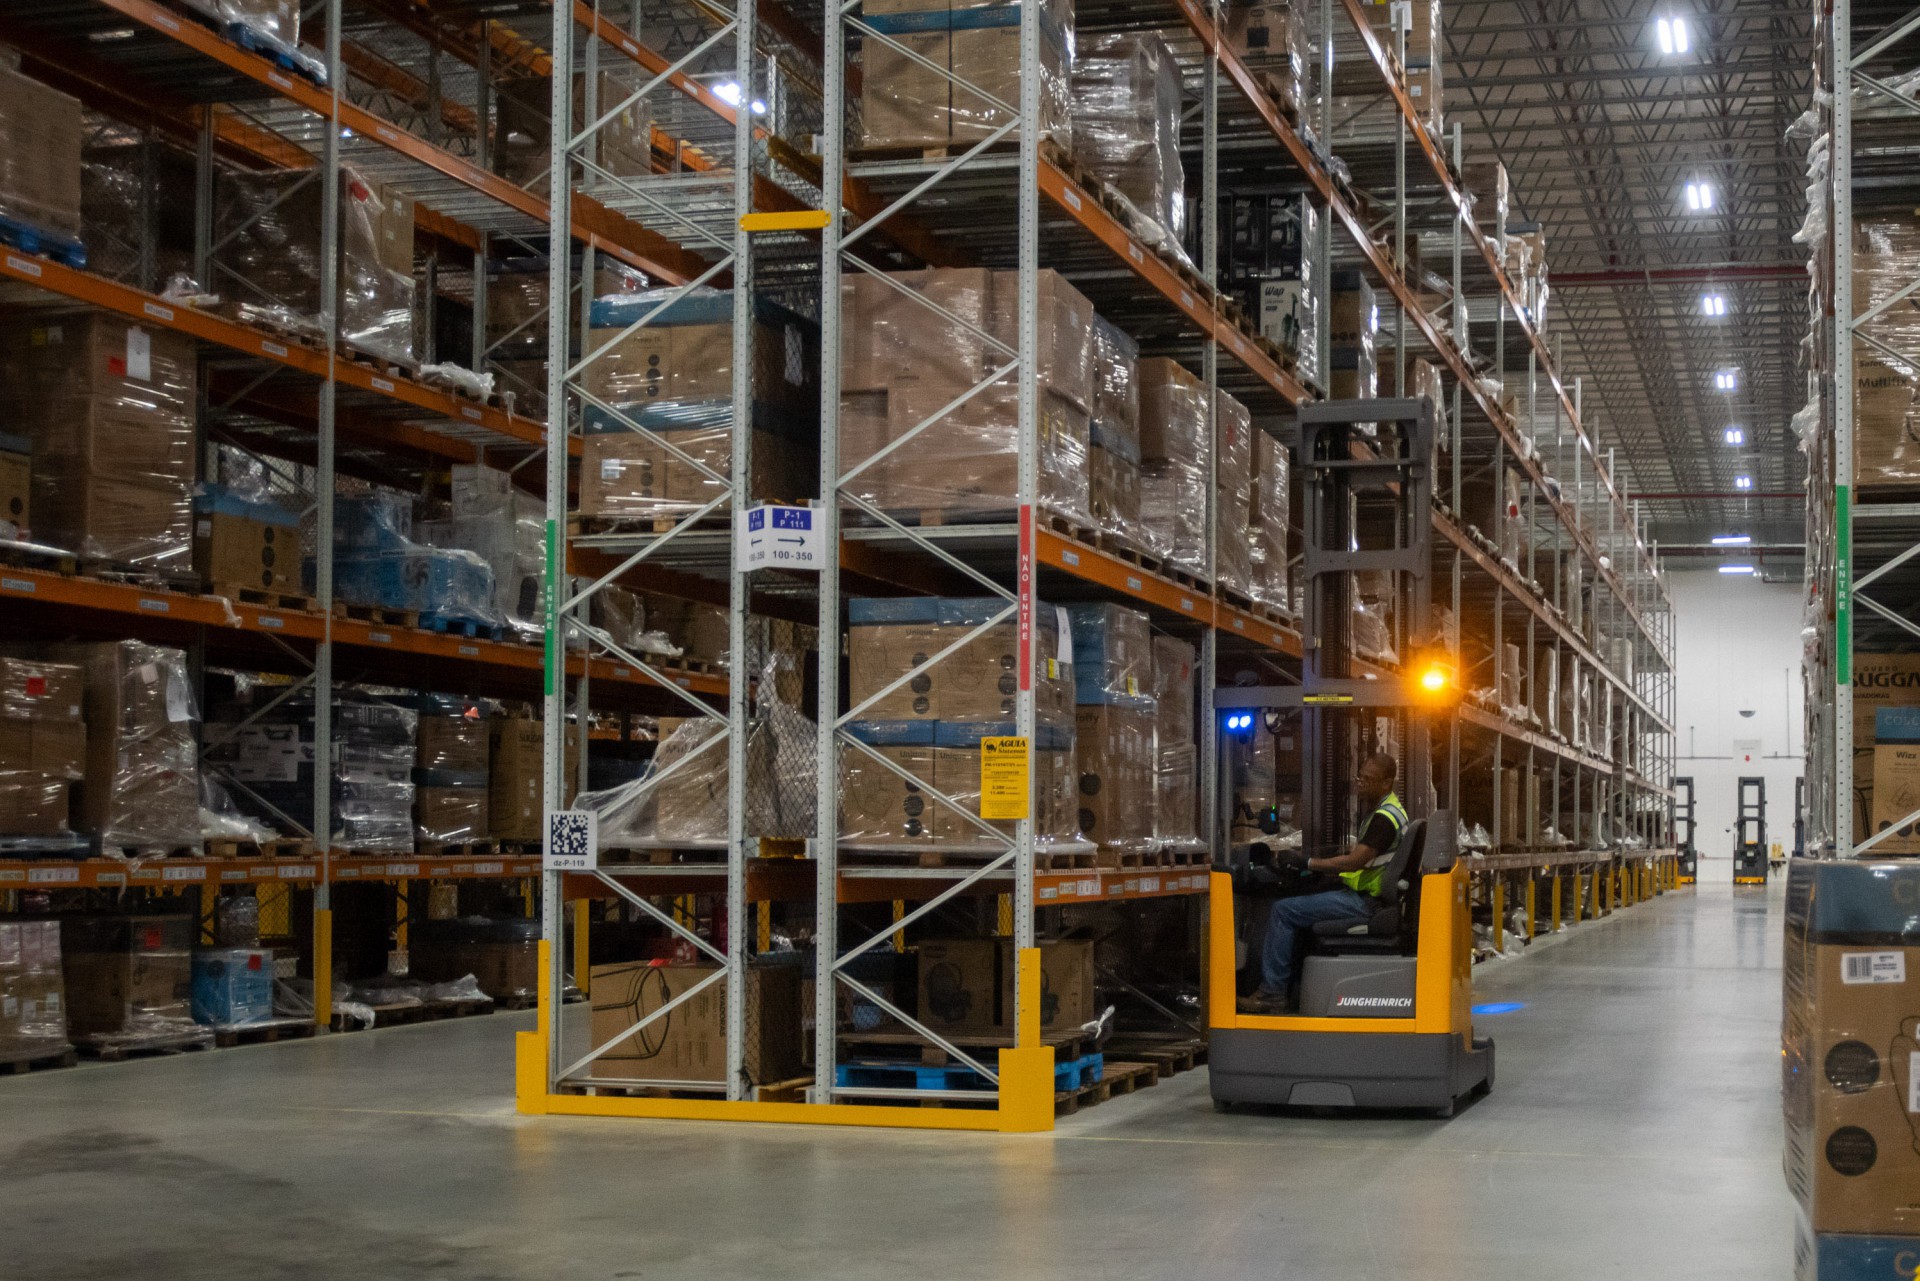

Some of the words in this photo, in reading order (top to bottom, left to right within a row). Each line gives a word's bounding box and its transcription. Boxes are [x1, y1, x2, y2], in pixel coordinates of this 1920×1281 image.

[1265, 286, 1285, 296] Wap
[785, 511, 800, 520] P-1
[773, 551, 813, 560] 100-350
[553, 859, 585, 867] dz-P-119
[1336, 996, 1413, 1007] JUNGHEINRICH
